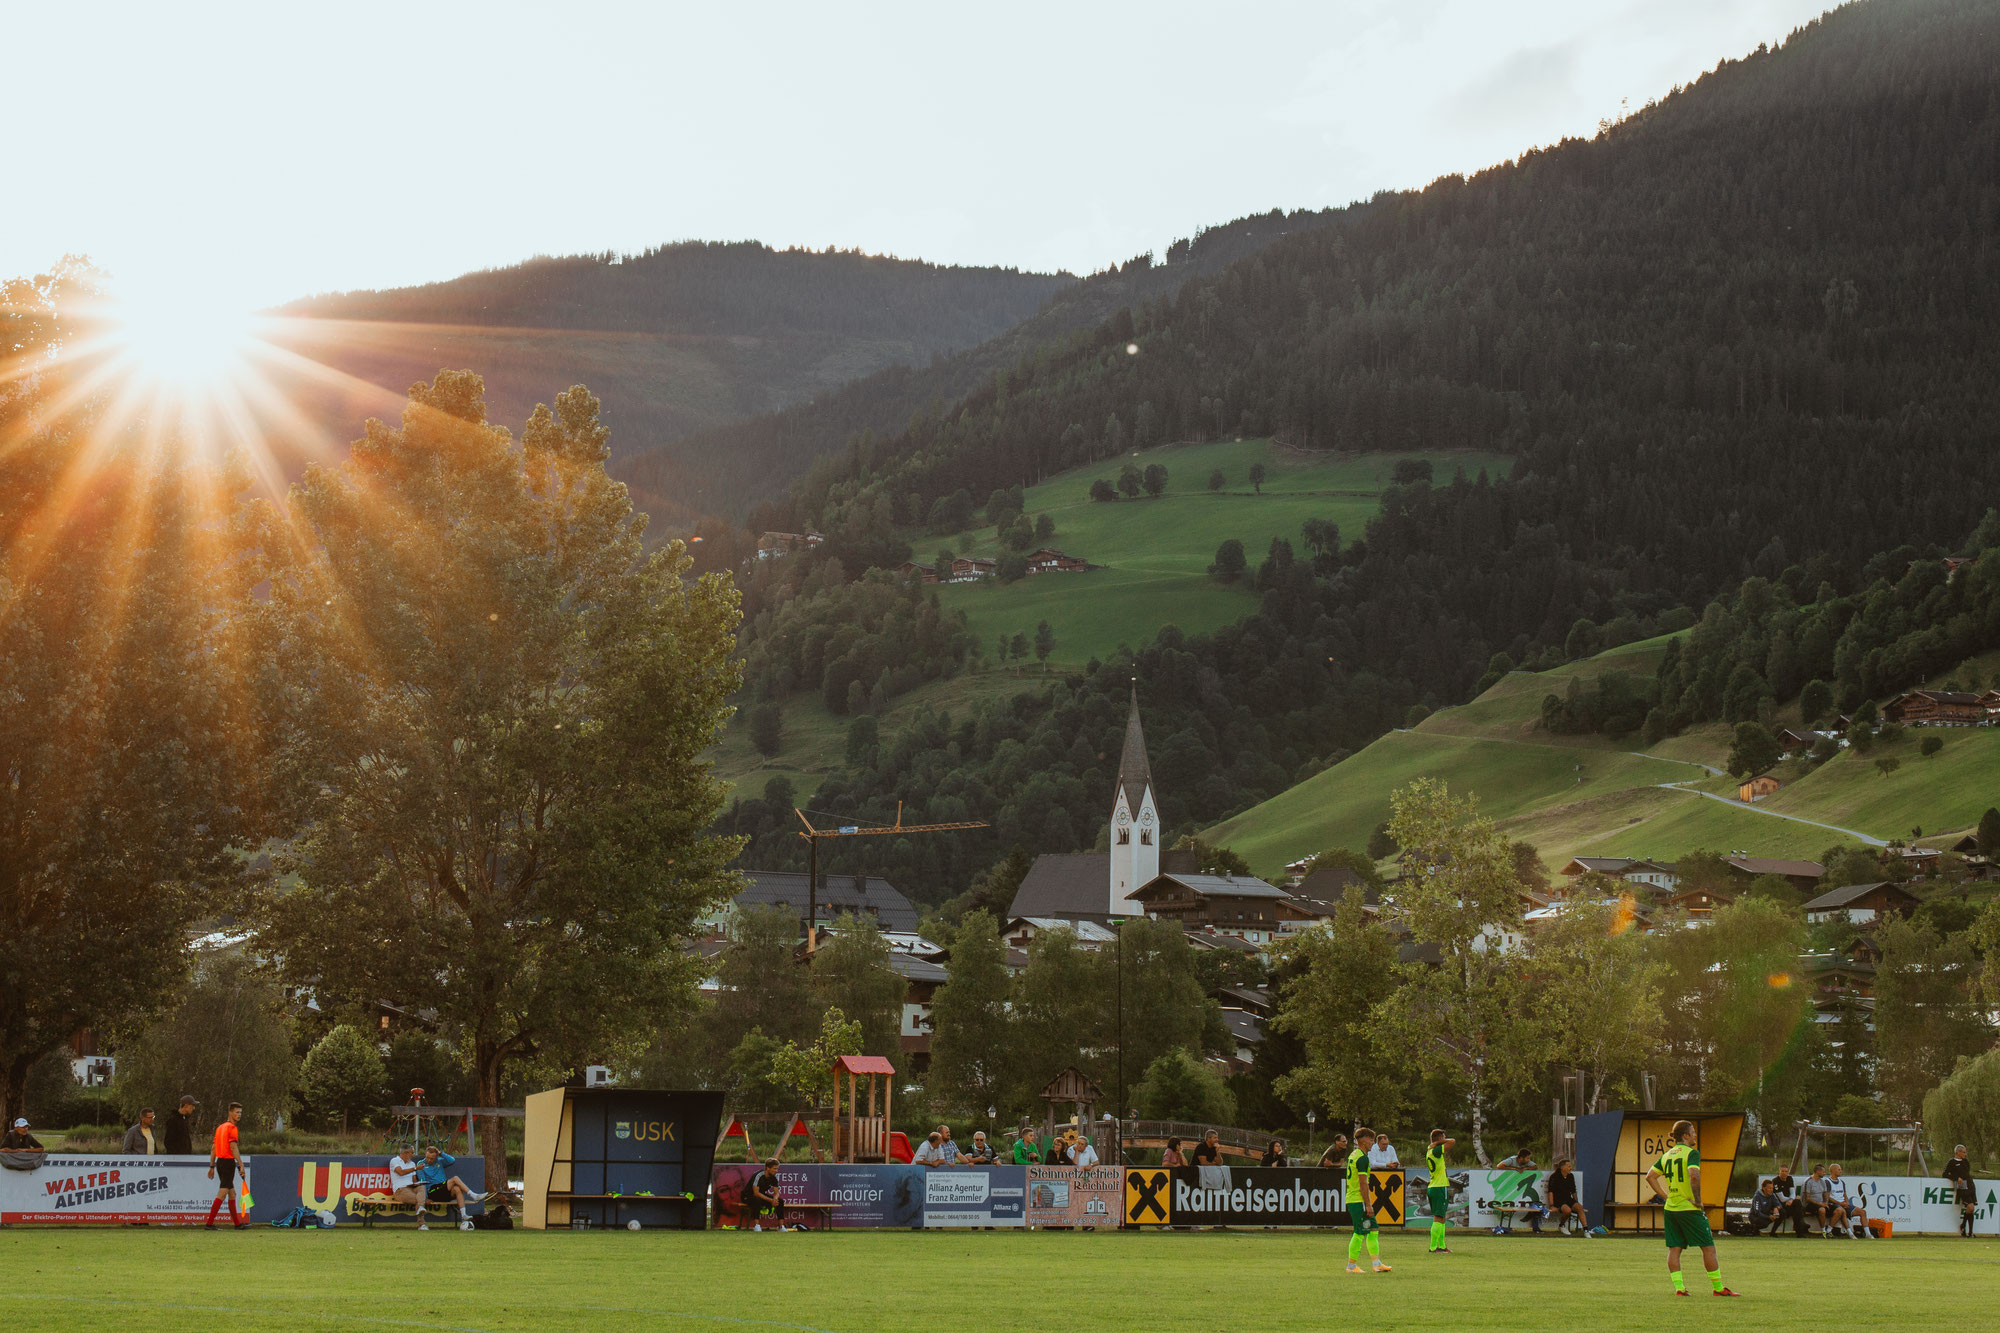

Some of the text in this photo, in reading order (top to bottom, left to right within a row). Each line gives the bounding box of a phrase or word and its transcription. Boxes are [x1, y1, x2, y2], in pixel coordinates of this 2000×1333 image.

[634, 1121, 675, 1141] USK
[1644, 1135, 1675, 1155] GÄS
[801, 1173, 808, 1182] &
[1030, 1167, 1120, 1179] Steinmetzbetrieb
[1664, 1158, 1684, 1183] 41
[45, 1169, 121, 1195] WALTER
[344, 1173, 392, 1189] UNTERB
[928, 1183, 984, 1194] Allianz Agentur
[1074, 1181, 1120, 1191] Reichholf
[55, 1176, 169, 1210] ALTENBERGER
[830, 1189, 884, 1201] maurer
[928, 1193, 982, 1202] Franz Rammler
[1175, 1178, 1347, 1213] Raiffeisenban
[1876, 1194, 1906, 1215] cps
